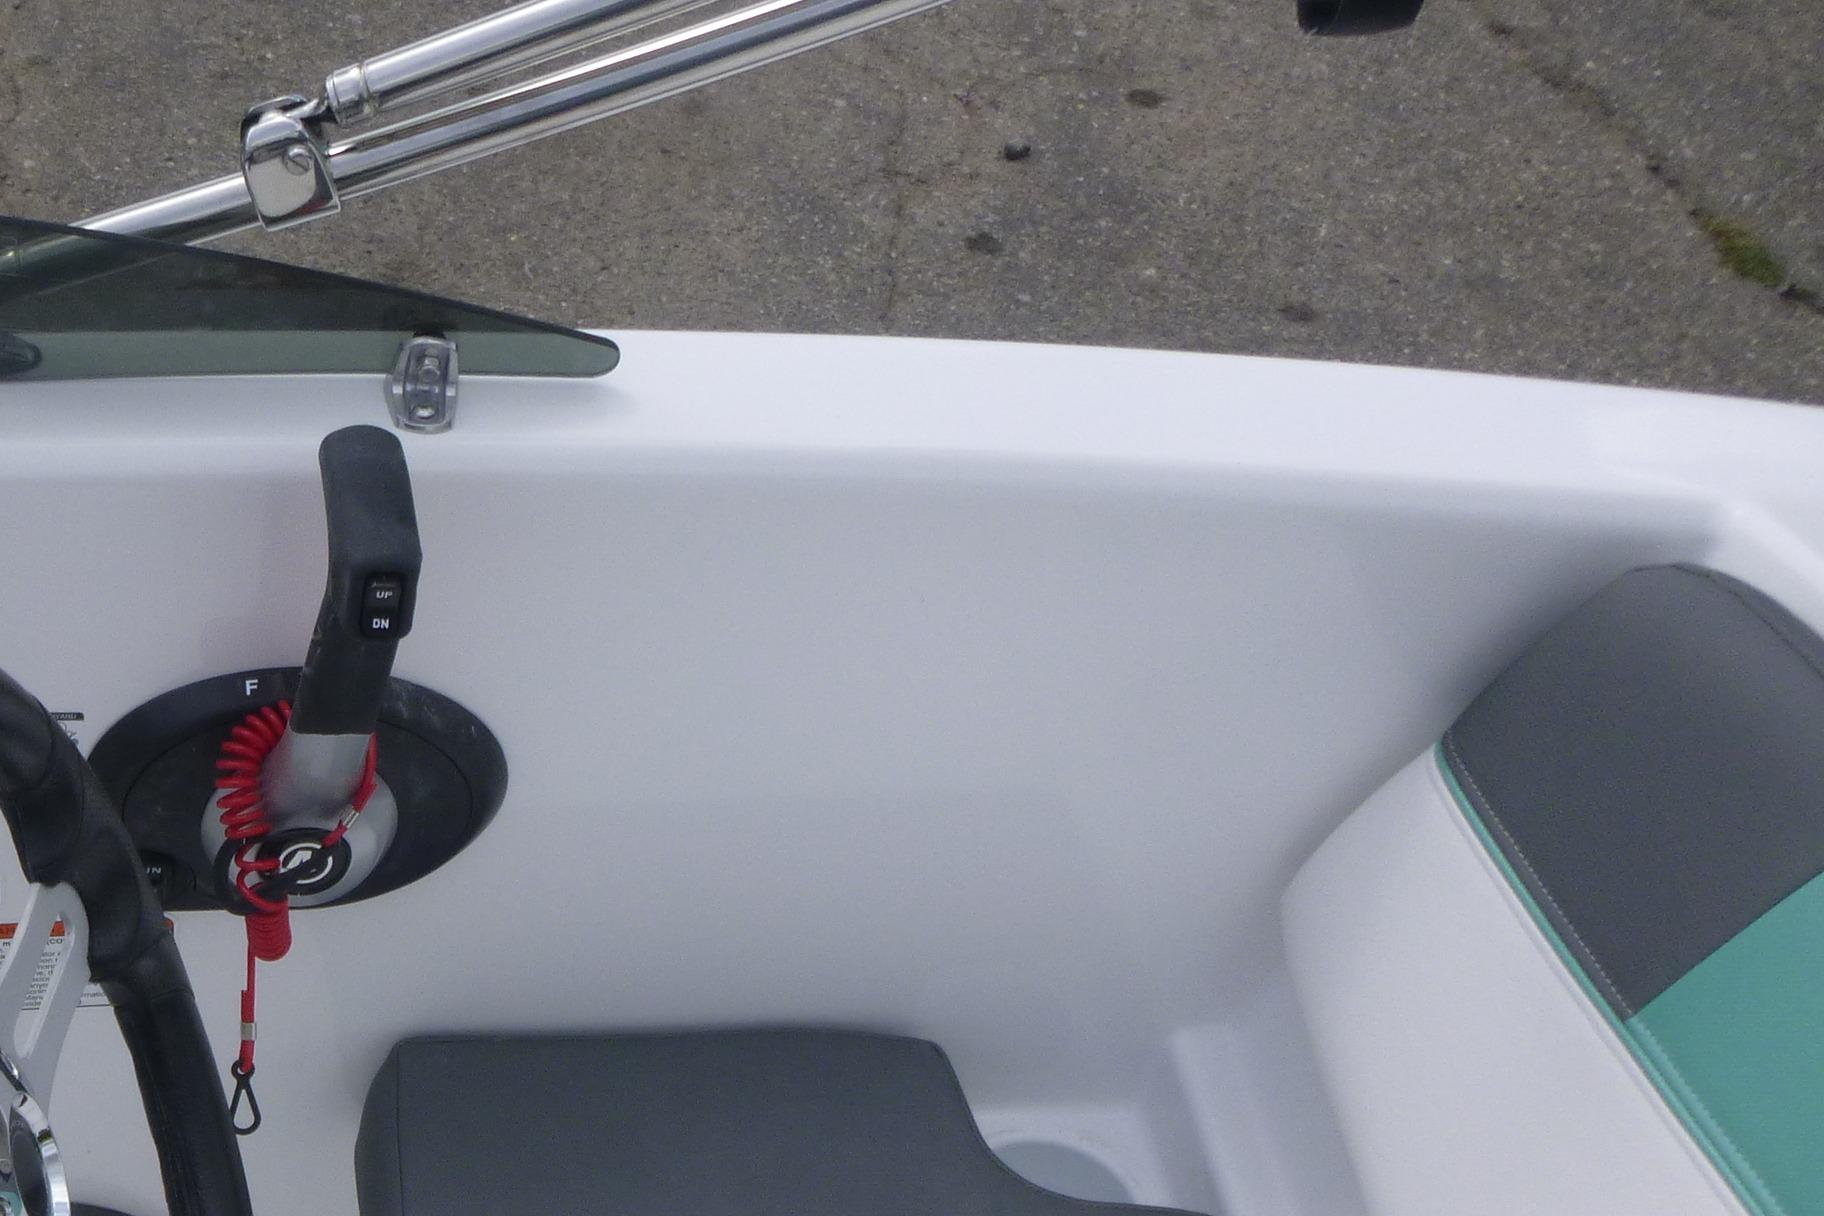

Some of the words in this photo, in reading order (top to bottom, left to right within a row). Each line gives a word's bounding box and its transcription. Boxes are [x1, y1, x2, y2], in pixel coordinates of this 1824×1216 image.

[376, 590, 393, 599] UP
[372, 617, 390, 630] DN
[245, 679, 258, 696] F
